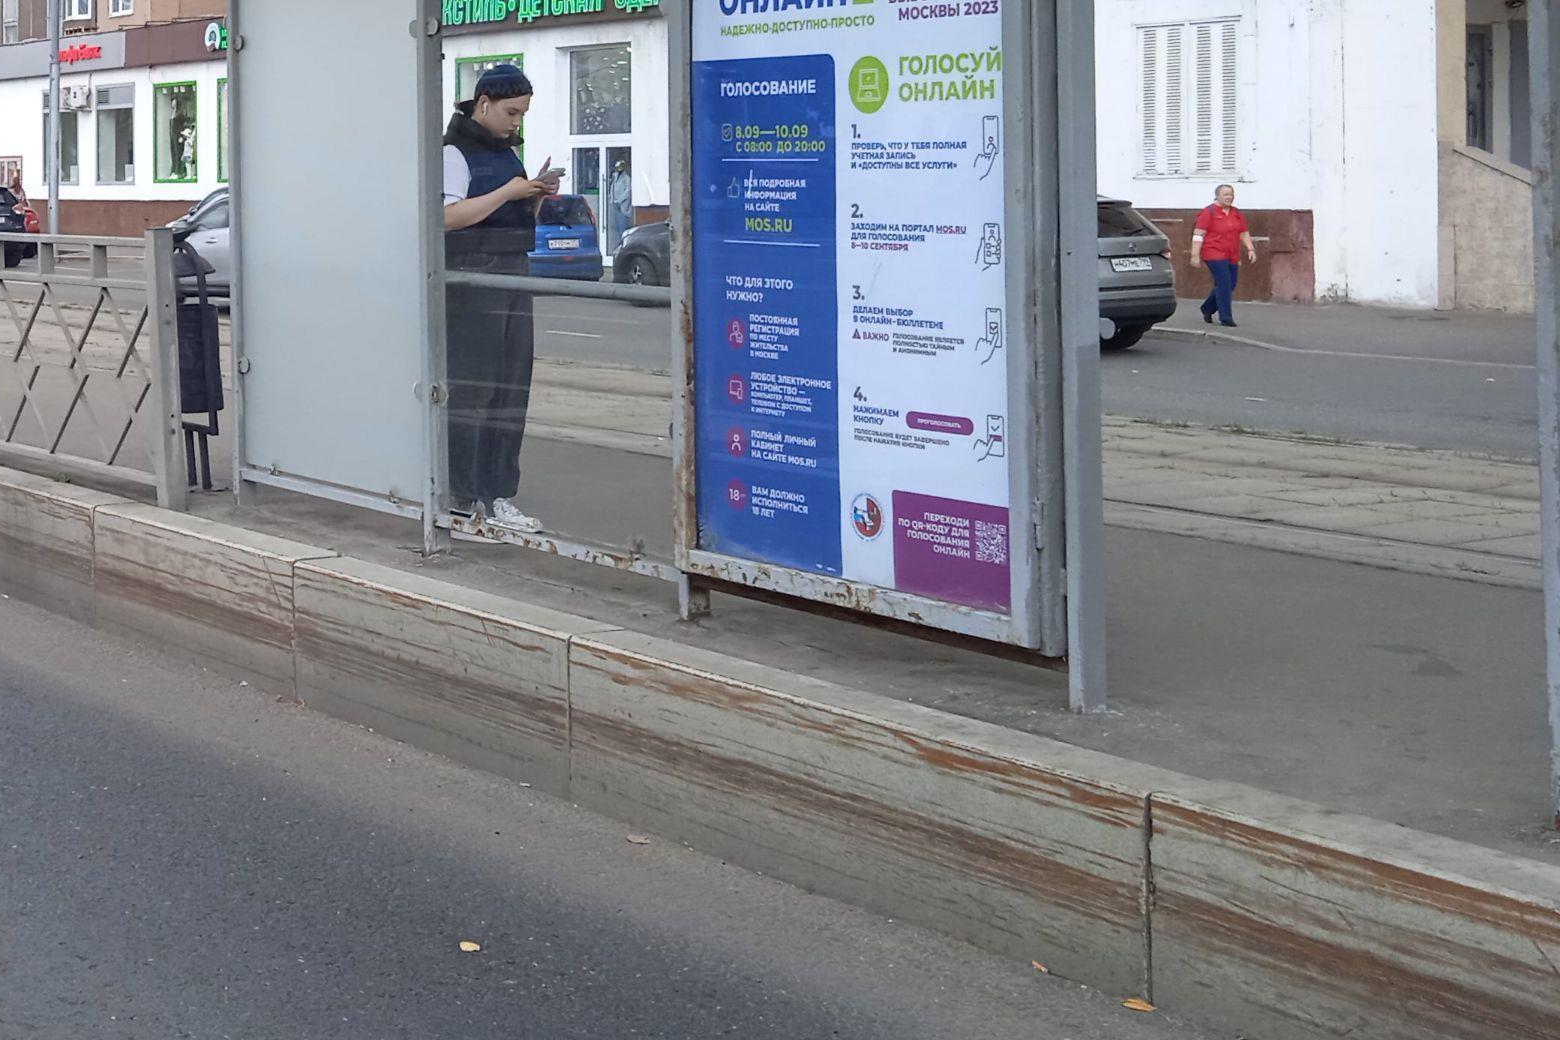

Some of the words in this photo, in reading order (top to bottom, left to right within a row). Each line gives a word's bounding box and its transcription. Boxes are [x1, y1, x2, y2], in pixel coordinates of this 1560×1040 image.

[898, 3, 960, 21] МОСКВЫ
[963, 0, 999, 17] 2023
[899, 45, 1002, 76] ГОЛОСУЙ
[720, 79, 817, 97] ГОЛОСОВАНИЕ
[898, 74, 996, 102] ОНЛАЙН
[851, 123, 861, 139] 1.
[744, 141, 773, 152] 08:00
[776, 141, 792, 154] ДО
[794, 140, 826, 152] 20:00
[888, 142, 903, 150] ЧТО
[904, 142, 909, 150] У
[911, 141, 930, 150] ТЕБЯ
[932, 141, 967, 150] ПОЛНАЯ
[851, 152, 885, 160] УЧЕТНАЯ
[885, 152, 916, 160] ЗАПИСЬ
[904, 161, 920, 169] ВСЕ
[759, 178, 807, 188] ПОДРОБНАЯ
[744, 191, 797, 201] ИНФОРМАЦИЯ
[744, 203, 754, 211] НА
[755, 201, 780, 212] САЙТЕ
[851, 203, 863, 219] 2.
[745, 217, 793, 233] MOS.RU
[851, 223, 887, 232] ЗАХОДИМ
[888, 224, 900, 232] НА
[901, 224, 934, 233] ПОРТАЛ
[936, 225, 967, 235] MOS.RU
[851, 233, 867, 241] ДЛЯ
[868, 233, 926, 242] ГОЛОСОВАНИЯ
[870, 243, 909, 251] СЕНТЯБРЯ
[725, 275, 743, 287] ЧТО
[744, 277, 763, 289] ДЛЯ
[764, 278, 794, 290] ЭТОГО
[726, 290, 764, 303] НУЖНО?
[852, 285, 865, 301] 3.
[853, 305, 884, 316] ДЕЛАЕМ
[885, 308, 914, 317] ВЫБОР
[749, 313, 798, 326] ПОСТОЯННАЯ
[749, 323, 800, 337] РЕГИСТРАЦИЯ
[862, 331, 889, 342] ВАЖНО
[750, 371, 776, 382] ЛЮБОЕ
[777, 374, 832, 390] ЭЛЕКТРОННОЕ
[750, 381, 798, 396] УСТРОЙСТВО
[853, 386, 867, 402] 4.
[853, 404, 899, 418] НАЖИМАЕМ
[853, 414, 884, 425] КНОПКУ
[751, 429, 782, 443] ПОЛНЫЙ
[784, 434, 817, 448] ЛИЧНЫЙ
[751, 439, 784, 452] КАБИНЕТ
[751, 450, 761, 459] НА
[762, 450, 787, 463] САЙТЕ
[751, 485, 769, 496] ВАМ
[769, 488, 805, 503] ДОЛЖНО
[751, 496, 809, 515] ИСПОЛНИТЬСЯ
[760, 508, 775, 518] ЛЕТ
[923, 512, 970, 528] ПЕРЕХОДИ
[898, 518, 910, 528] ПО
[911, 521, 949, 538] QR-КОДУ
[950, 526, 970, 538] ДЛЯ
[906, 530, 970, 549] ГОЛОСОВАНИЯ
[933, 544, 970, 559] ОНЛАЙН
